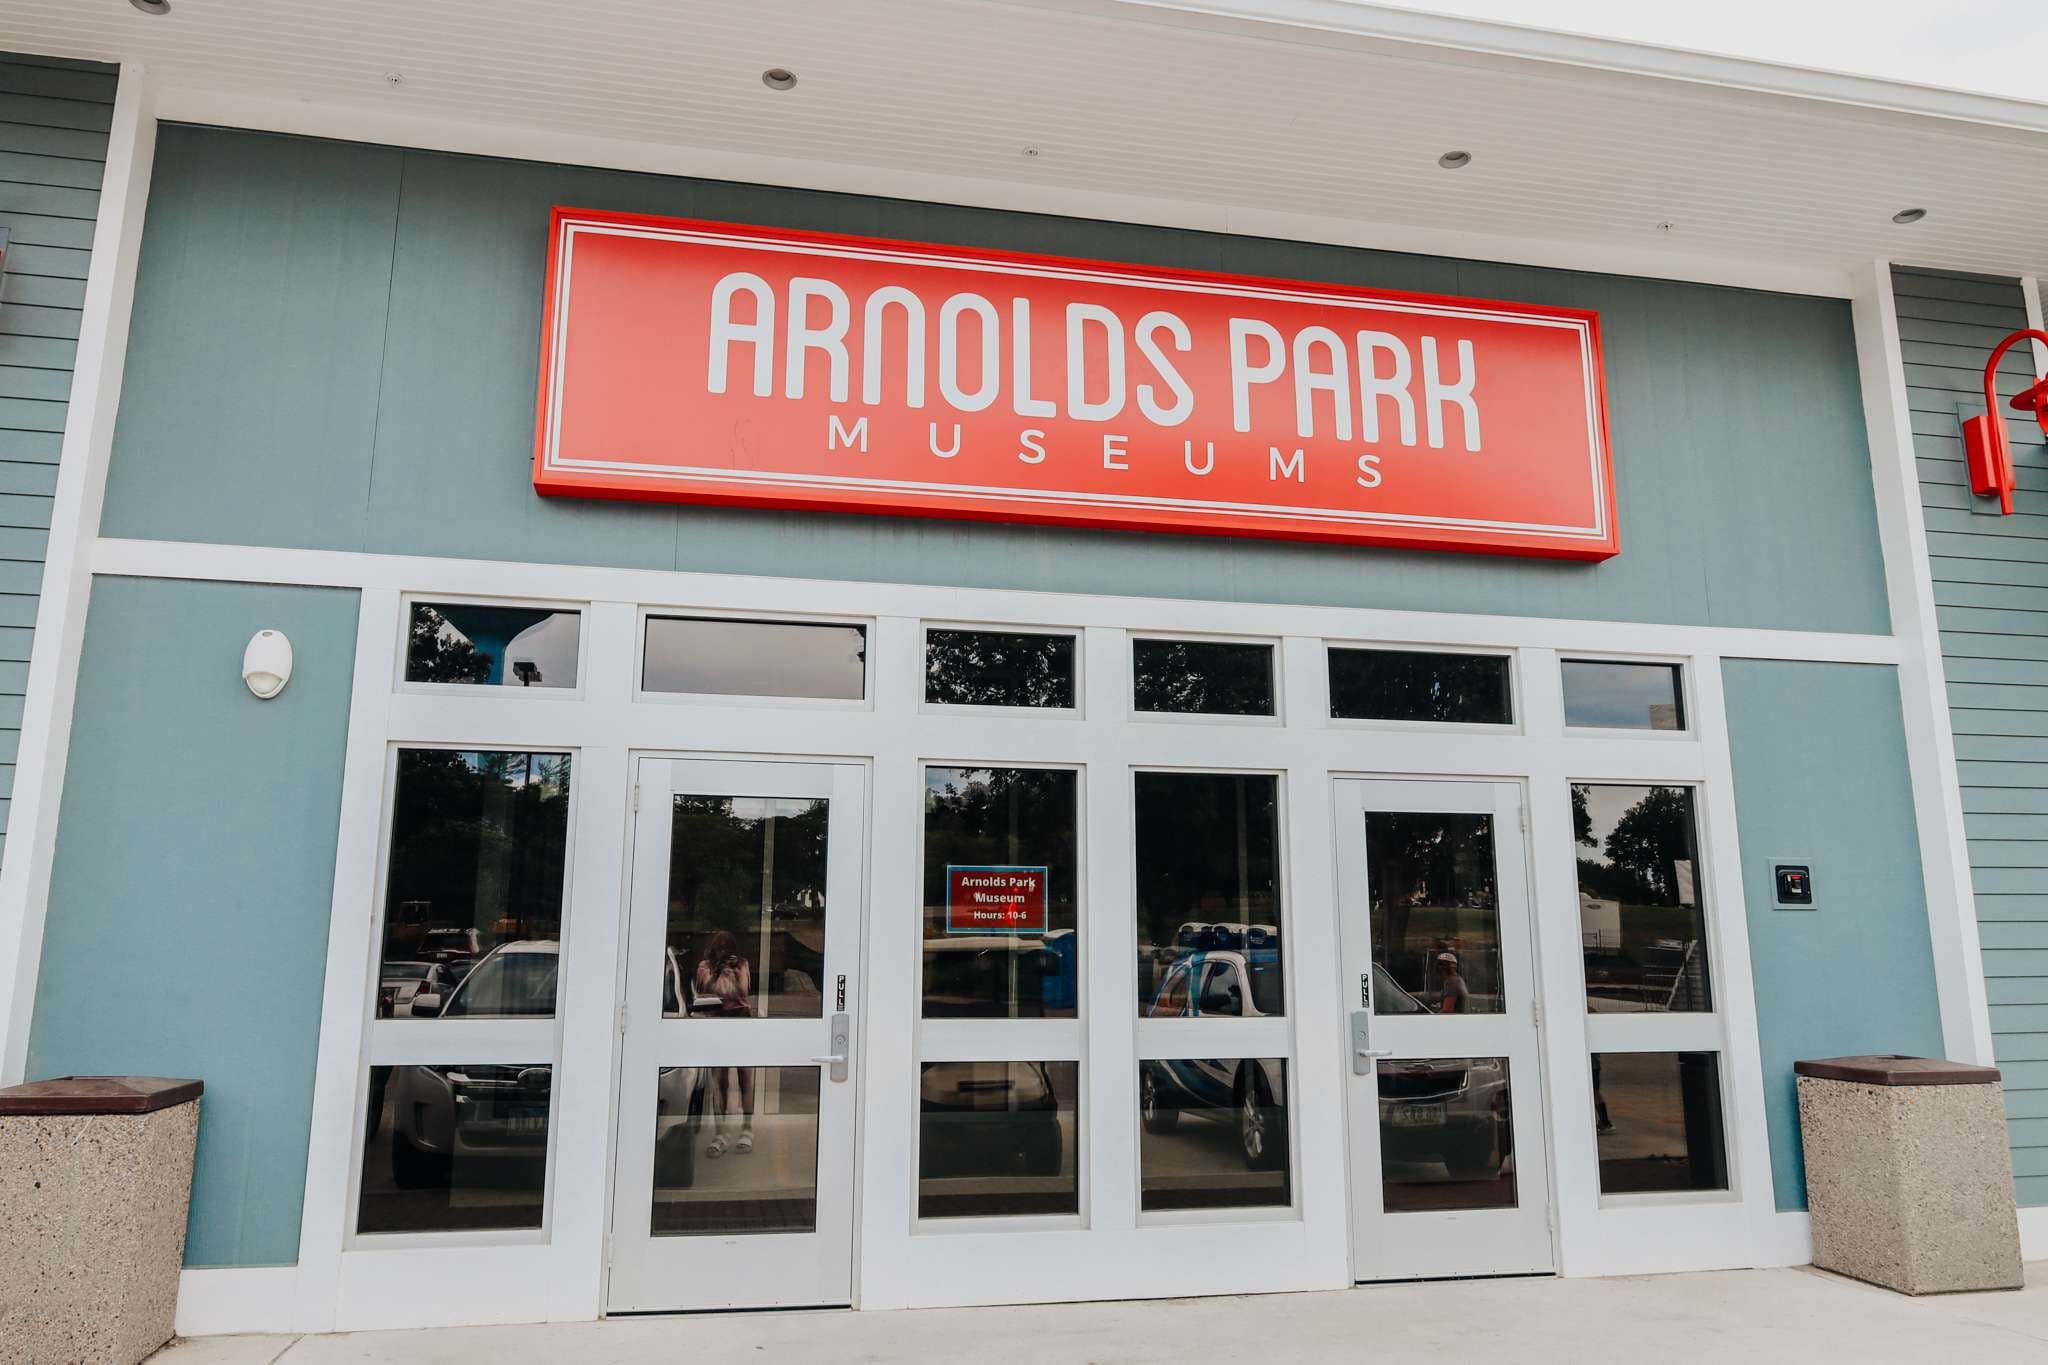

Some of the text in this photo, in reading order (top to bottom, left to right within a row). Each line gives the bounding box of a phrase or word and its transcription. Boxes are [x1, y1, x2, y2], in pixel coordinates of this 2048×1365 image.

[707, 272, 1482, 452] ARNOLDS PARK
[828, 415, 1382, 488] MUSEUMS
[961, 877, 1036, 887] Arnolds Park
[974, 892, 1025, 903] Museum
[973, 911, 1027, 920] Hours: 10-6
